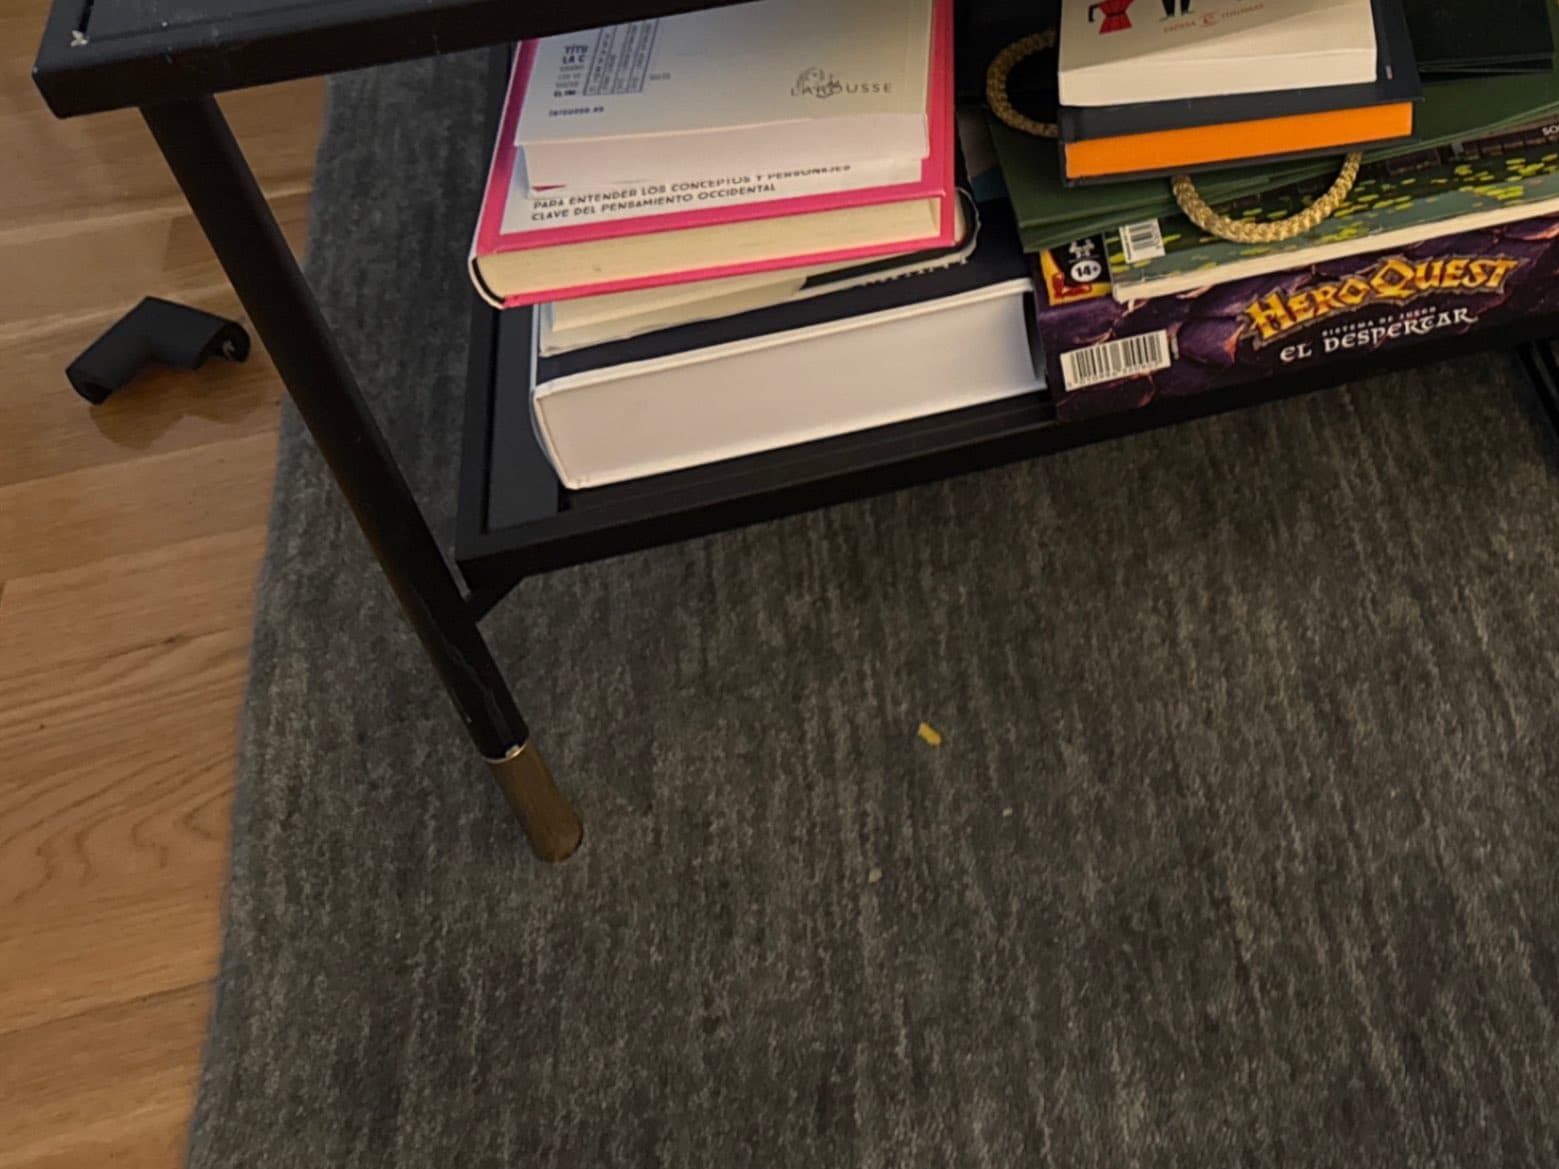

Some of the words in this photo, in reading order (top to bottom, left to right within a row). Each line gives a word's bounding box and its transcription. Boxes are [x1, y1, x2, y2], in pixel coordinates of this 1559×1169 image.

[531, 209, 569, 222] CLAVE
[573, 206, 597, 216] DEL
[601, 193, 694, 213] PENSAMIENTO
[697, 183, 777, 201] OCCIDENTAL
[533, 198, 564, 210] PARA
[569, 189, 638, 206] ENTENDER
[641, 184, 667, 197] LOS
[1075, 264, 1099, 278] 14+
[1279, 342, 1313, 363] EL
[1323, 307, 1479, 354] DESPERTAR
